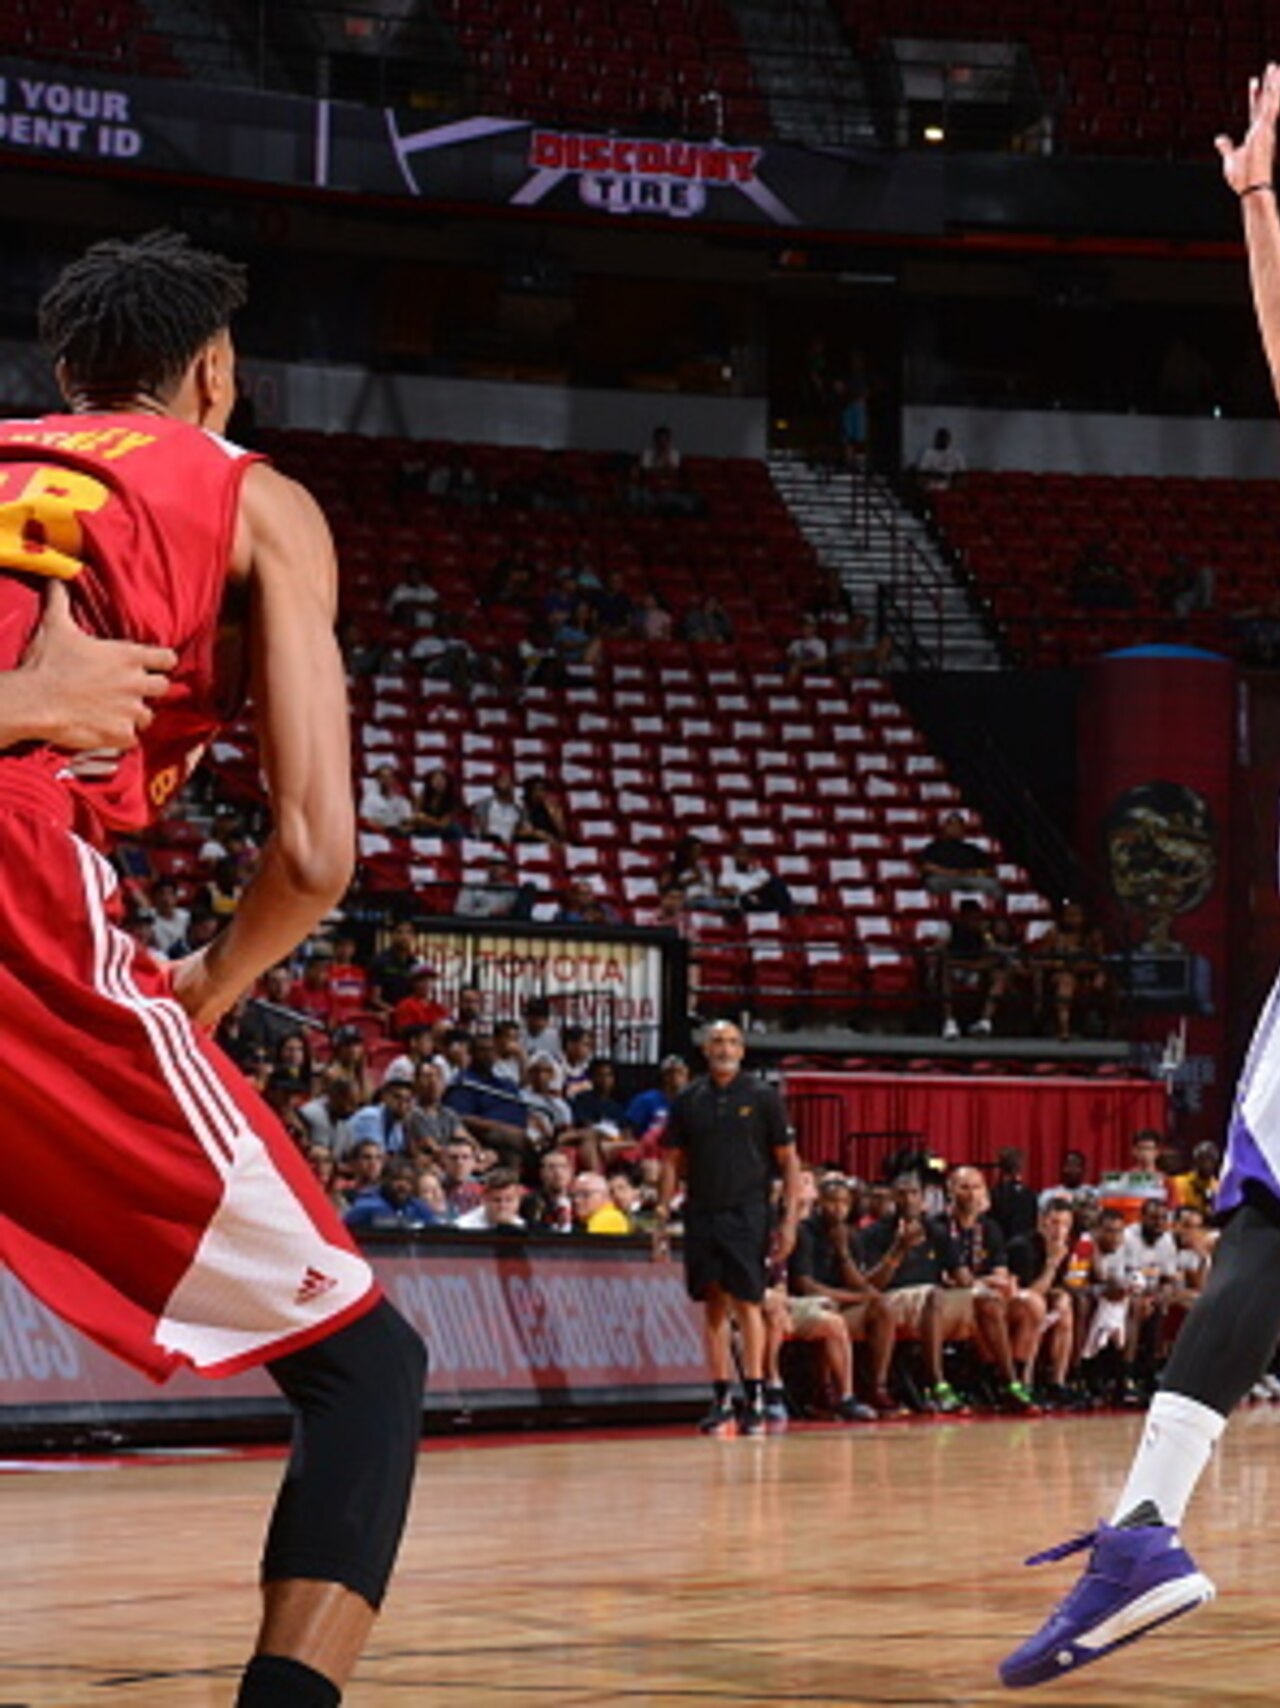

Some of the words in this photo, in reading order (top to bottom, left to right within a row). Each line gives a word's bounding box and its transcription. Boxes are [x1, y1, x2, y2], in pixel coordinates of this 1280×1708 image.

[19, 79, 129, 122] YOUR
[98, 125, 140, 157] ID
[532, 131, 763, 184] DISCOUNT
[593, 177, 692, 210] TIRE
[0, 463, 111, 579] 8
[477, 950, 624, 983] TOYOTA
